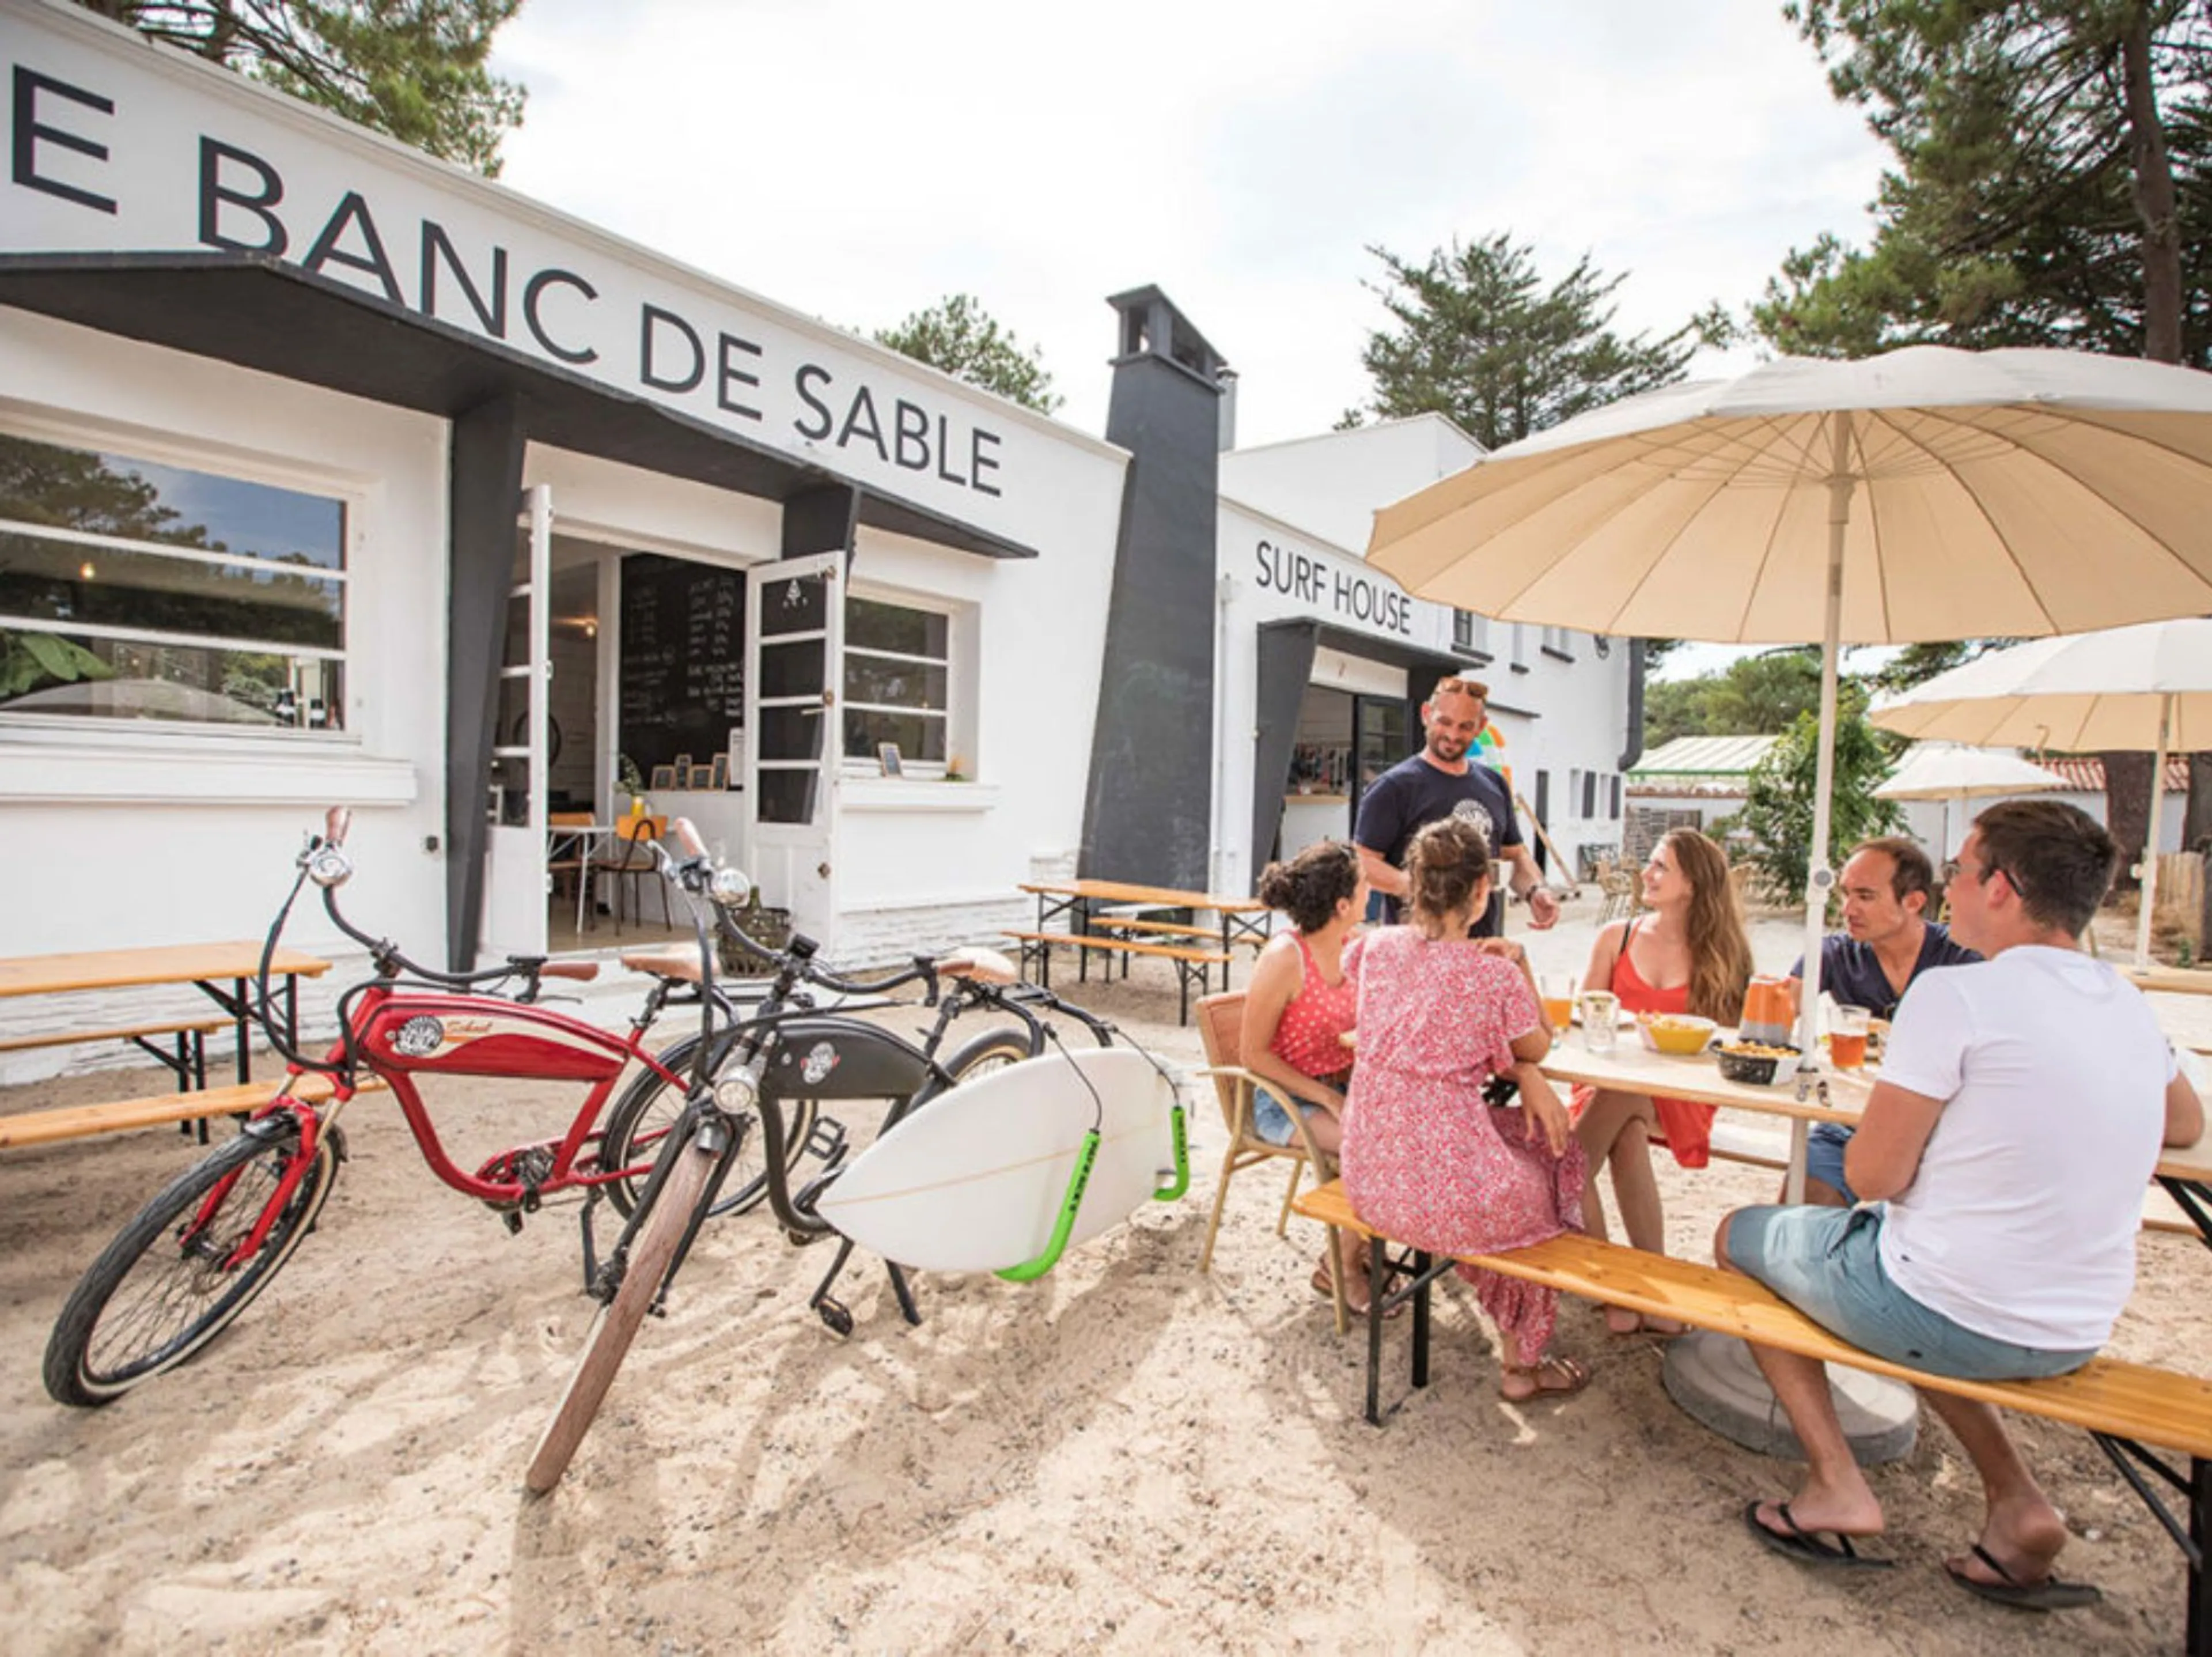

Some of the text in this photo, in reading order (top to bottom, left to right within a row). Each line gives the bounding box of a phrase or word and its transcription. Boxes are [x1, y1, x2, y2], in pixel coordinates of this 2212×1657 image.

[12, 63, 1002, 497] E BANC DE SABLE
[1256, 540, 1411, 635] SURF HOUSE
